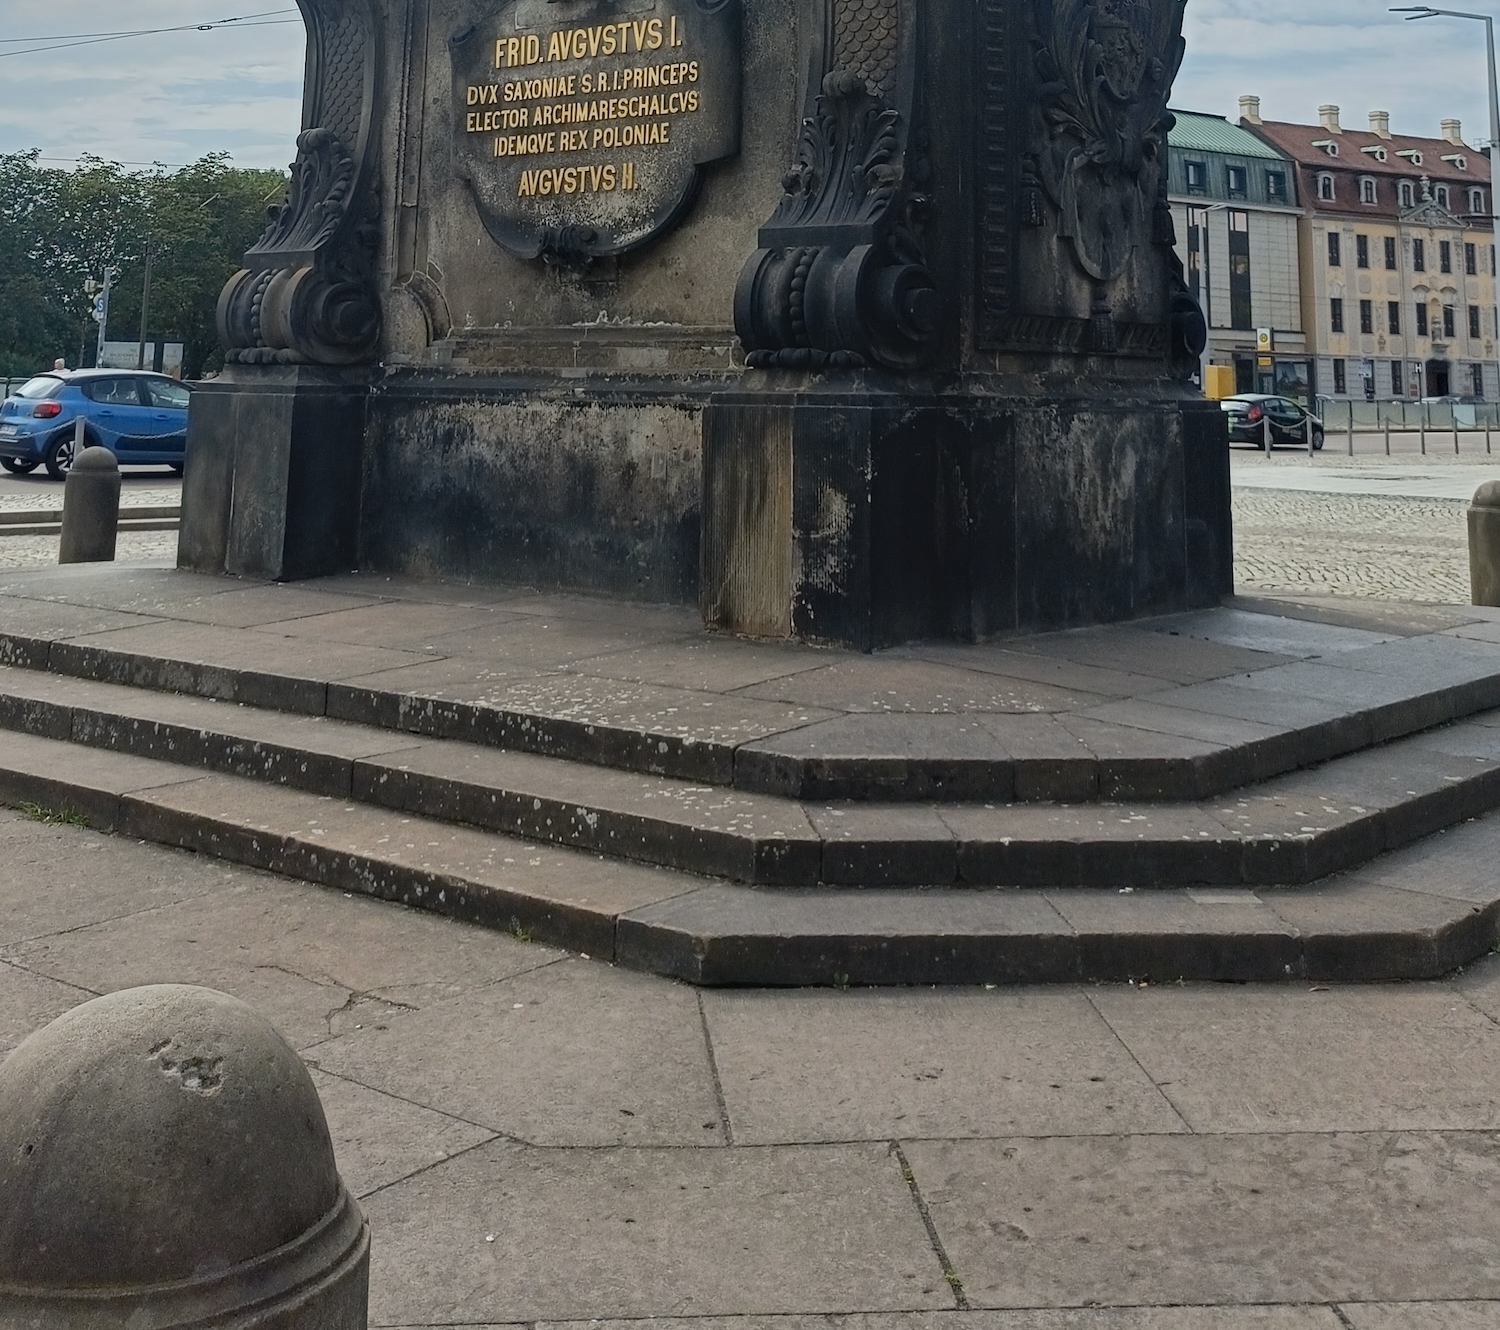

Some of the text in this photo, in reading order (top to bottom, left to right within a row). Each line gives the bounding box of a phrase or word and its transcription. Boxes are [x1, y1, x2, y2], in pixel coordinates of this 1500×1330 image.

[495, 15, 682, 69] FRID. AVGVSTVS I.
[466, 84, 499, 106] DVX
[503, 75, 576, 102] SAXONIAE
[466, 90, 699, 133] ELECTOR ARCHIMARESCHALCVS
[494, 122, 670, 157] IDEMQVE REX POLONIAE
[517, 164, 616, 197] AVGVSTVS
